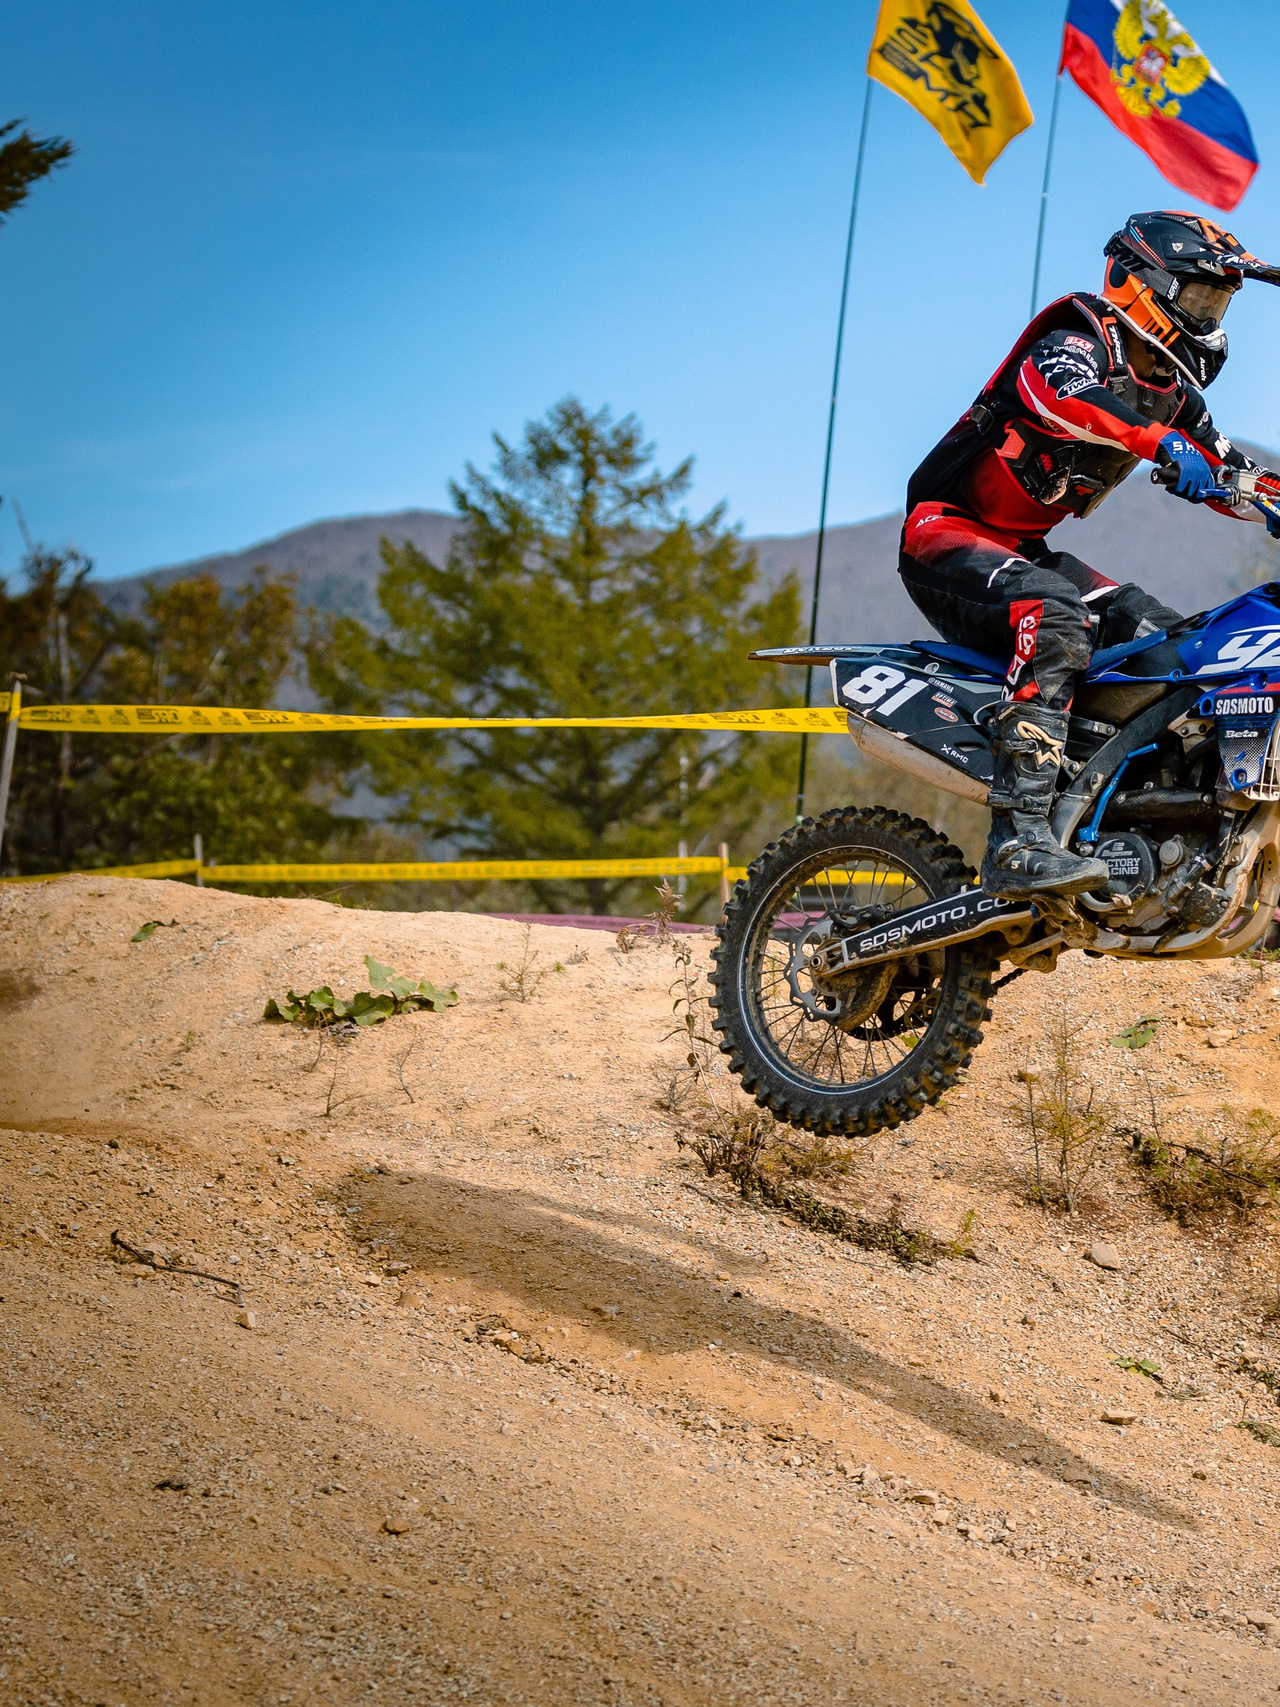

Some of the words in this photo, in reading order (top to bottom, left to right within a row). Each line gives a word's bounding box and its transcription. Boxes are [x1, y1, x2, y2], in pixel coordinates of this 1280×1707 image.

[1107, 239, 1158, 273] EATT
[1166, 276, 1179, 301] LEATT
[1108, 325, 1124, 365] THOR
[1199, 356, 1208, 382] Airoh
[841, 665, 929, 717] 81
[934, 679, 955, 693] YAMAHA
[1215, 696, 1274, 716] SDSMOTO
[1224, 729, 1259, 739] Beta
[1103, 857, 1142, 869] ACTORY
[1110, 866, 1140, 876] CING
[859, 898, 1016, 952] SDSMOTO.CO
